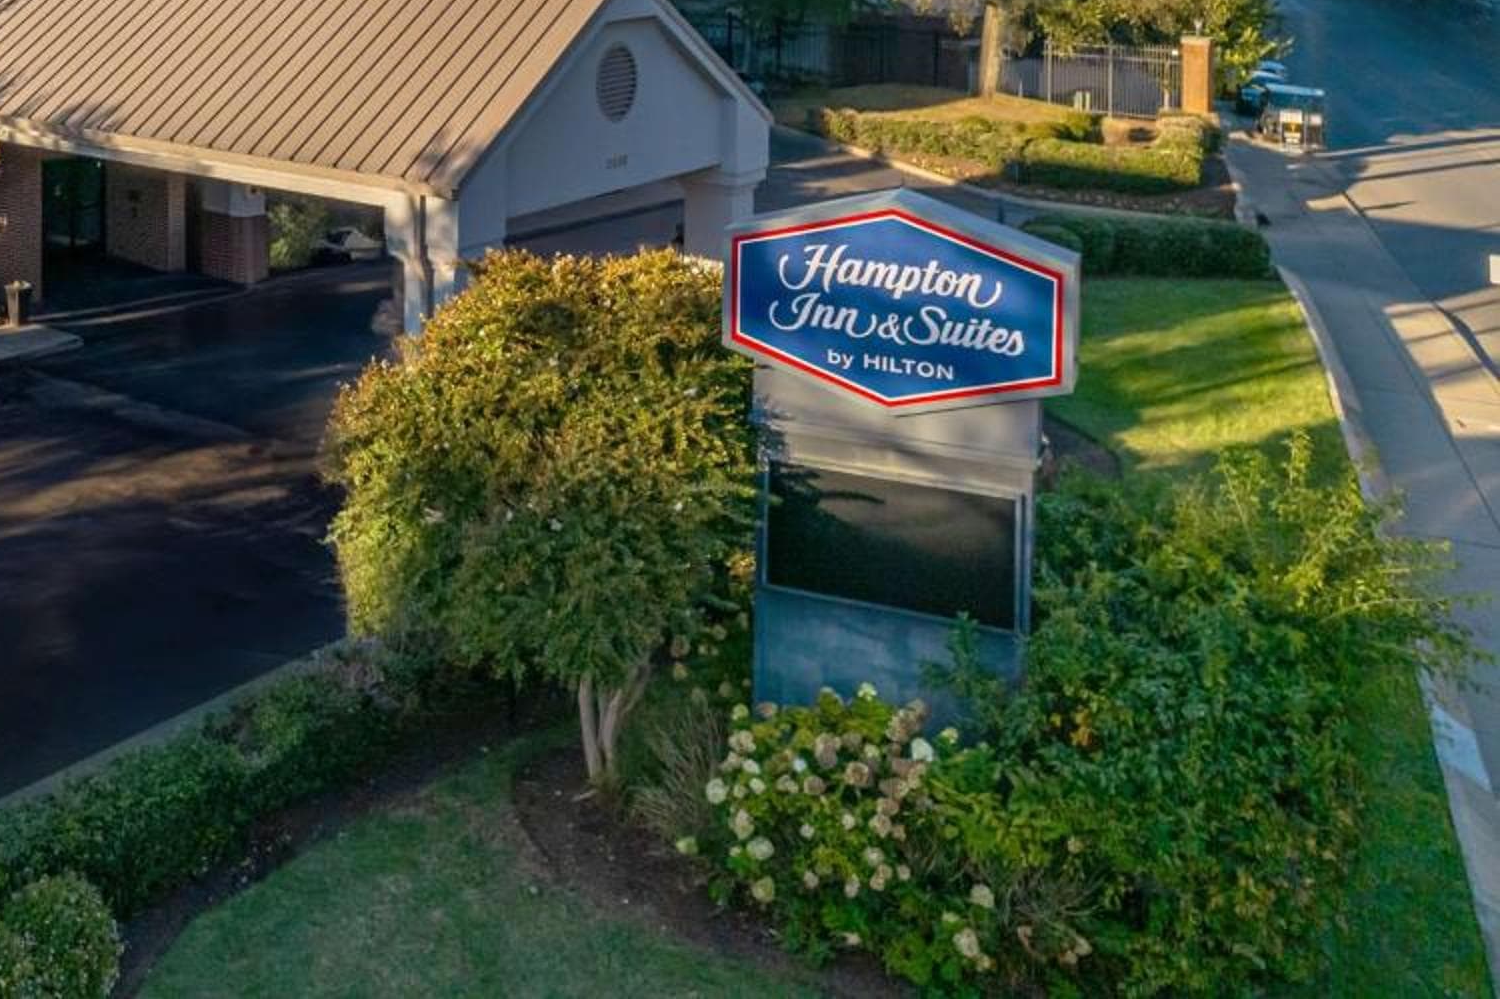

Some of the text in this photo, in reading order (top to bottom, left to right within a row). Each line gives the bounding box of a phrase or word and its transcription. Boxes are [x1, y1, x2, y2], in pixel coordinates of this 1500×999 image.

[778, 244, 1002, 309] Hampton
[768, 292, 1025, 357] Inn & Suites
[826, 348, 955, 381] by HILTON
